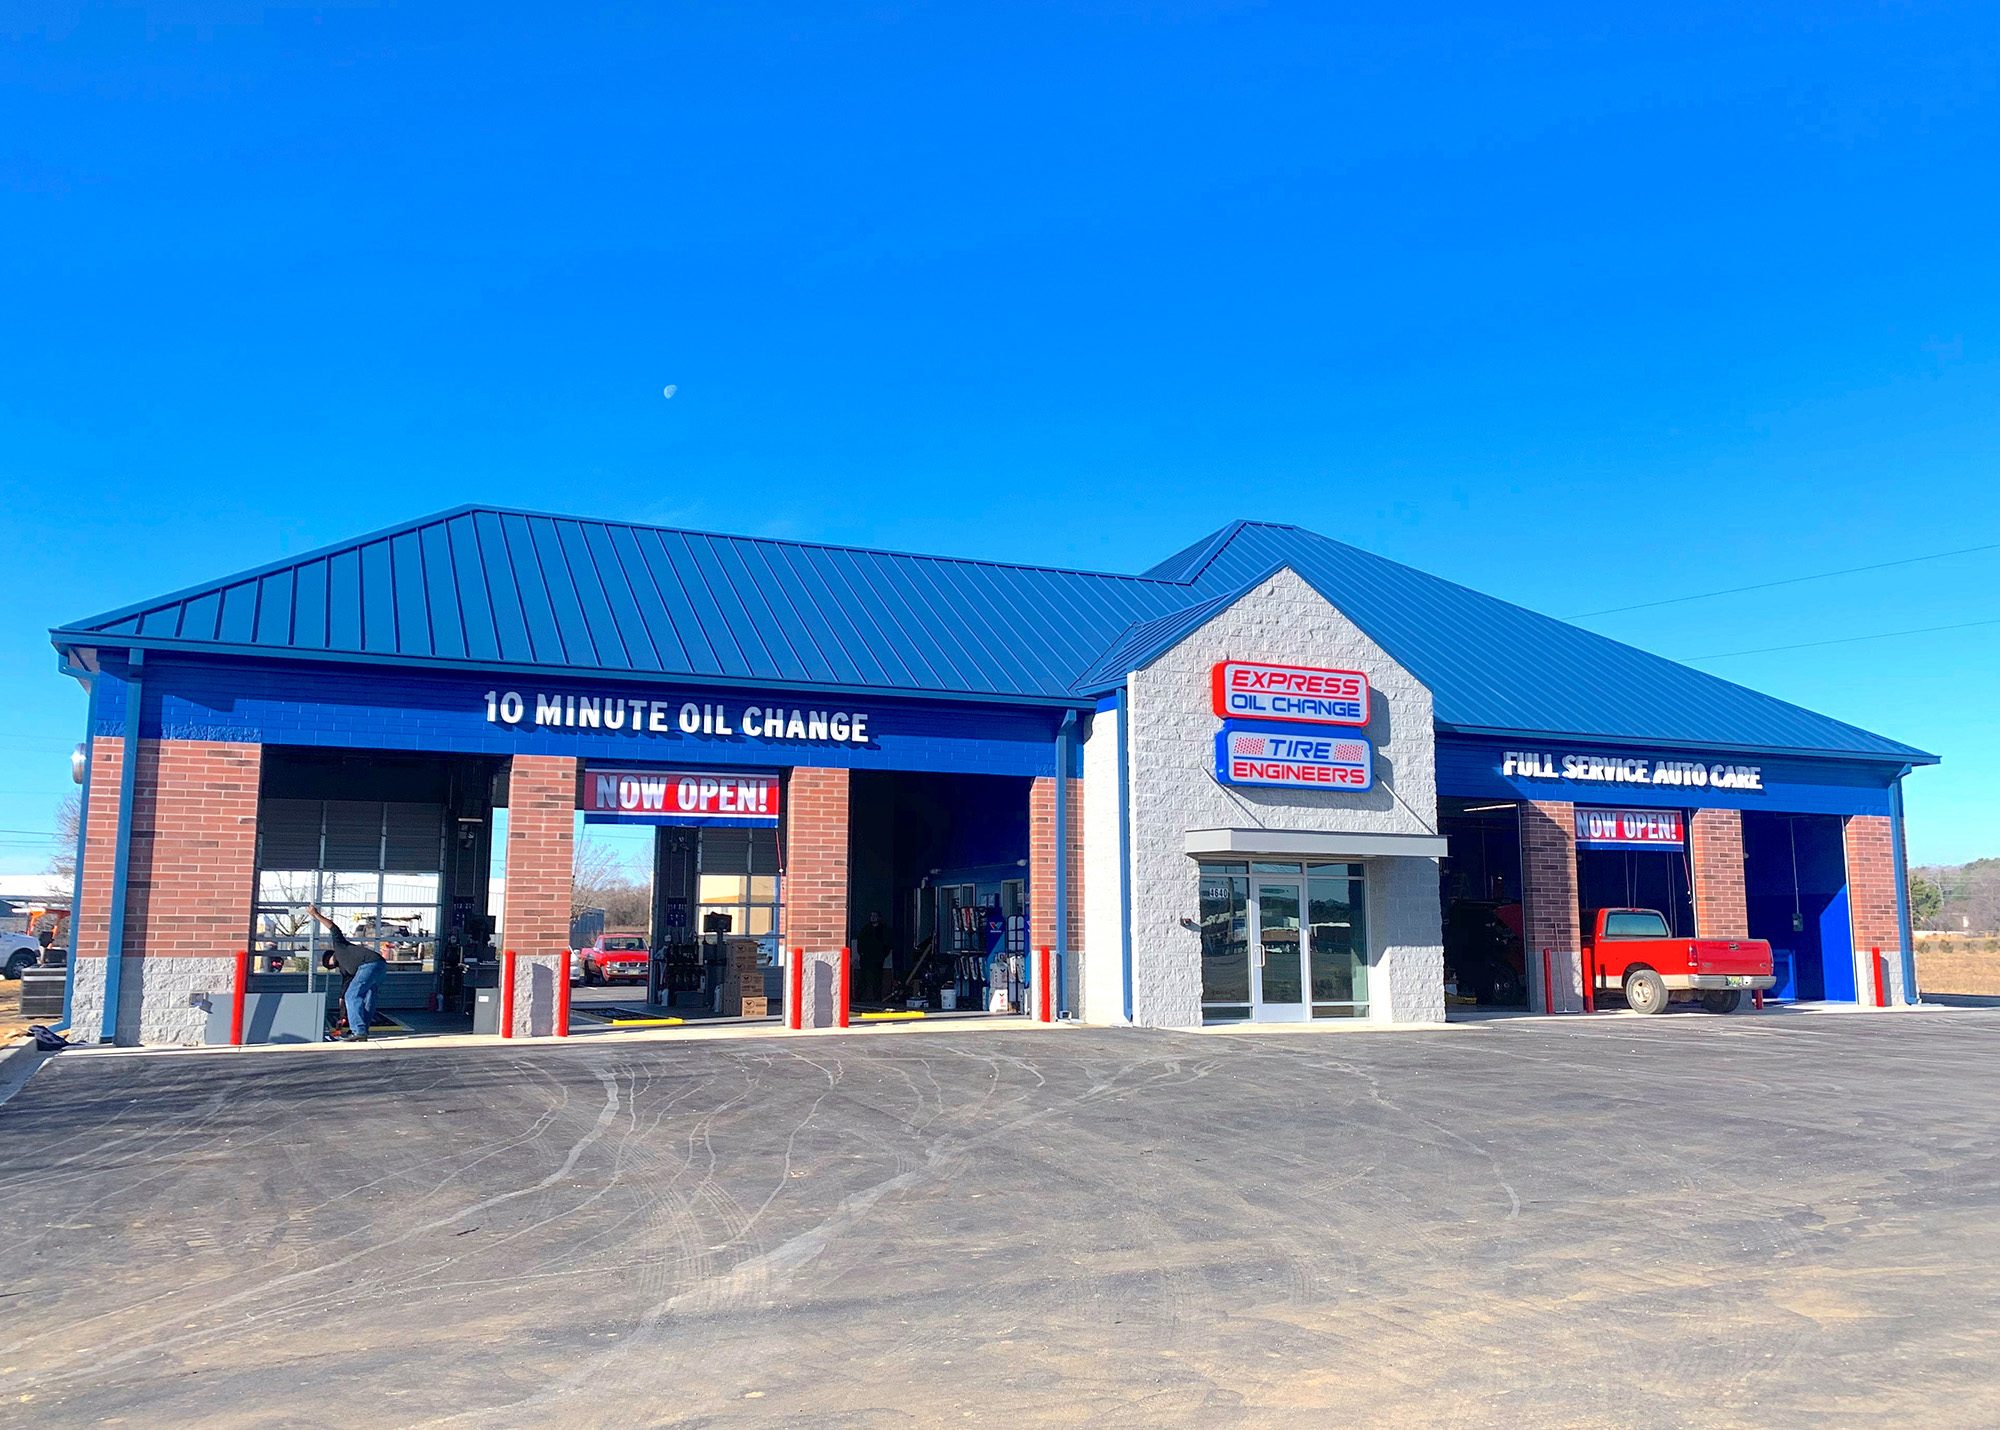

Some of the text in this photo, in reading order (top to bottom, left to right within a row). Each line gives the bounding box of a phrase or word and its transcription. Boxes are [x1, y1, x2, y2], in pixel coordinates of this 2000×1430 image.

[1231, 669, 1360, 696] EXPRESS
[484, 690, 869, 742] 10 MINUTE OIL CHANGE
[1231, 694, 1361, 718] OIL CHANGE
[1269, 739, 1332, 760] TIRE
[1233, 762, 1365, 785] ENGINEERS
[1503, 751, 1763, 790] FULL SERVICE AUTO CARE
[596, 775, 768, 813] NOW OPEN!
[1576, 811, 1677, 840] NOW OPEN!
[1210, 888, 1228, 898] 4640
